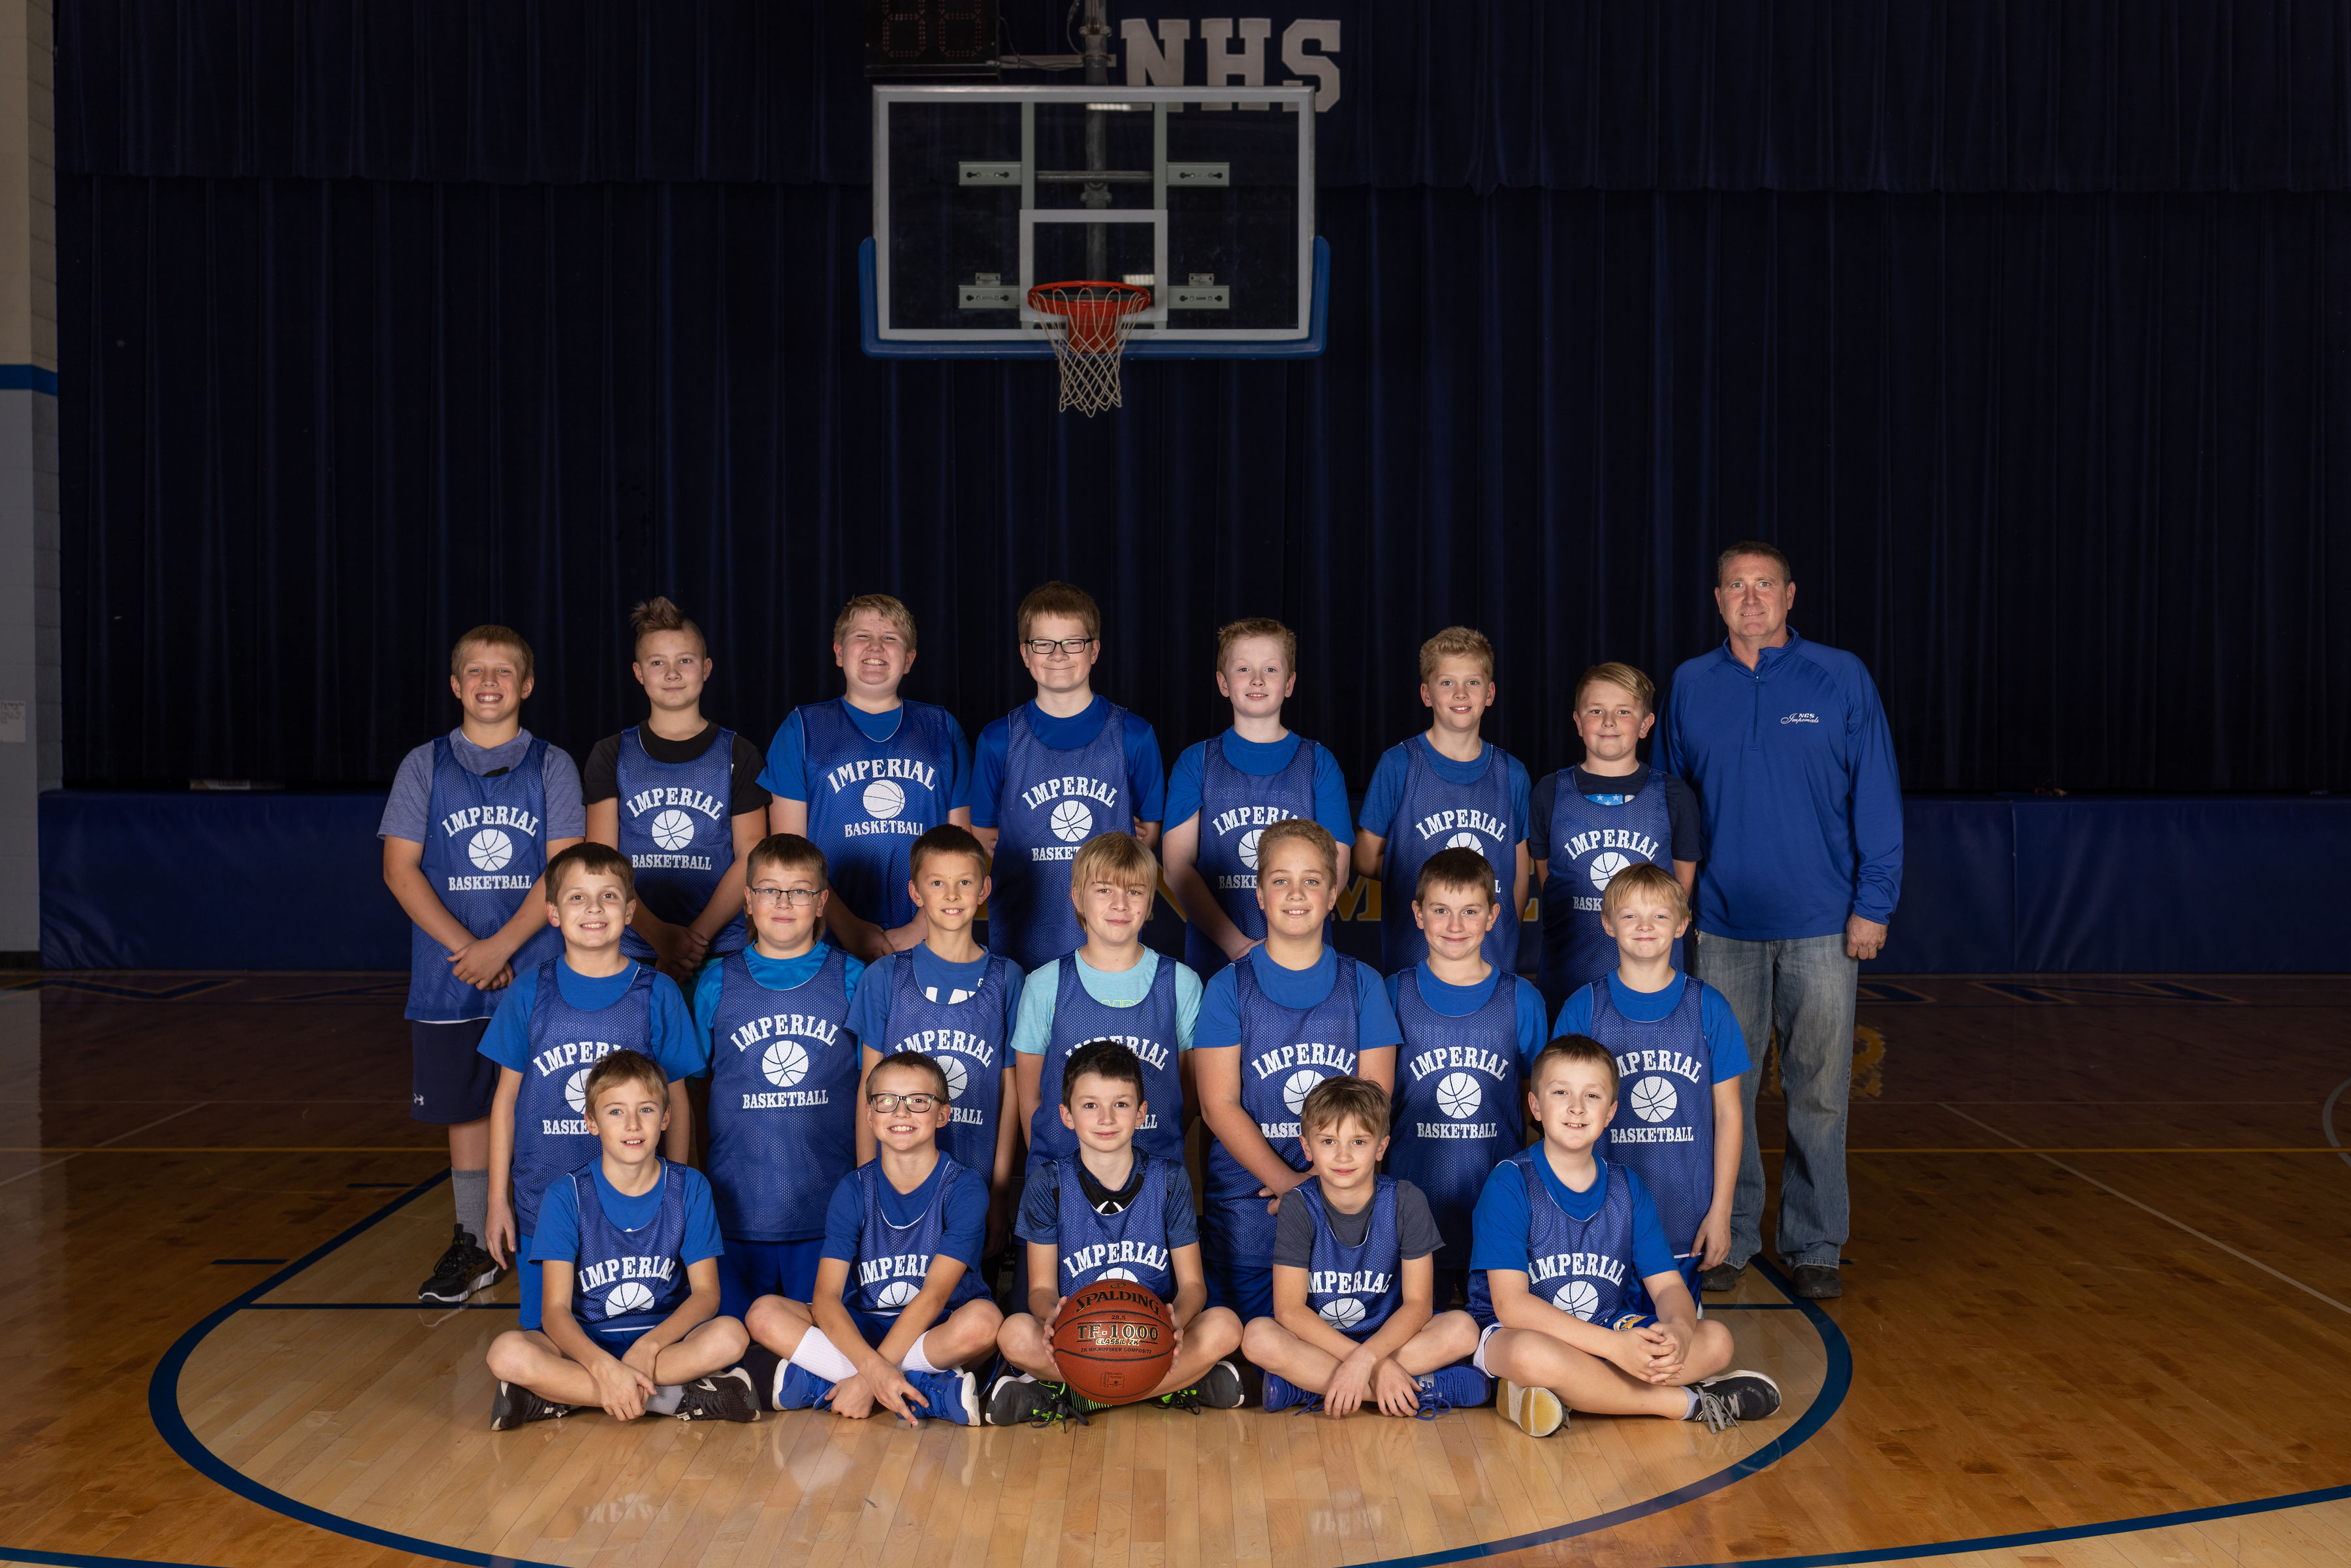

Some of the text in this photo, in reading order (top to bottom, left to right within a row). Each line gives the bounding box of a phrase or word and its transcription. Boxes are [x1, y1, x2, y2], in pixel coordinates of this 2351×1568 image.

[1120, 18, 1341, 112] NHS
[827, 758, 936, 794] IMPERIAL
[1021, 776, 1118, 810] IMPERIAL
[626, 787, 724, 821] IMPERIAL
[441, 805, 539, 838] IMPERIAL
[1415, 808, 1507, 843] IMPERIAL
[631, 854, 712, 871] BASKETBALL
[1563, 829, 1659, 862] IMPERIAL
[447, 874, 532, 891] BASKETBALL
[730, 1013, 839, 1053] IMPERIAL
[1251, 1042, 1357, 1081] IMPERIAL
[1409, 1046, 1509, 1082] IMPERIAL
[1615, 1049, 1703, 1085] MPERIAL
[742, 1089, 829, 1110] BASKETBALL
[1416, 1122, 1497, 1140] BASKETBALL
[1610, 1126, 1695, 1144] BASKETBALL
[577, 1255, 676, 1293] IMPERIAL
[857, 1253, 929, 1287] IMPERI
[1063, 1240, 1168, 1278] IMPERIAL
[1527, 1252, 1627, 1287] IMPERIAL
[1307, 1269, 1394, 1294] MPERIAL
[1076, 1290, 1160, 1316] SPALDING
[1076, 1323, 1159, 1341] TF-1000
